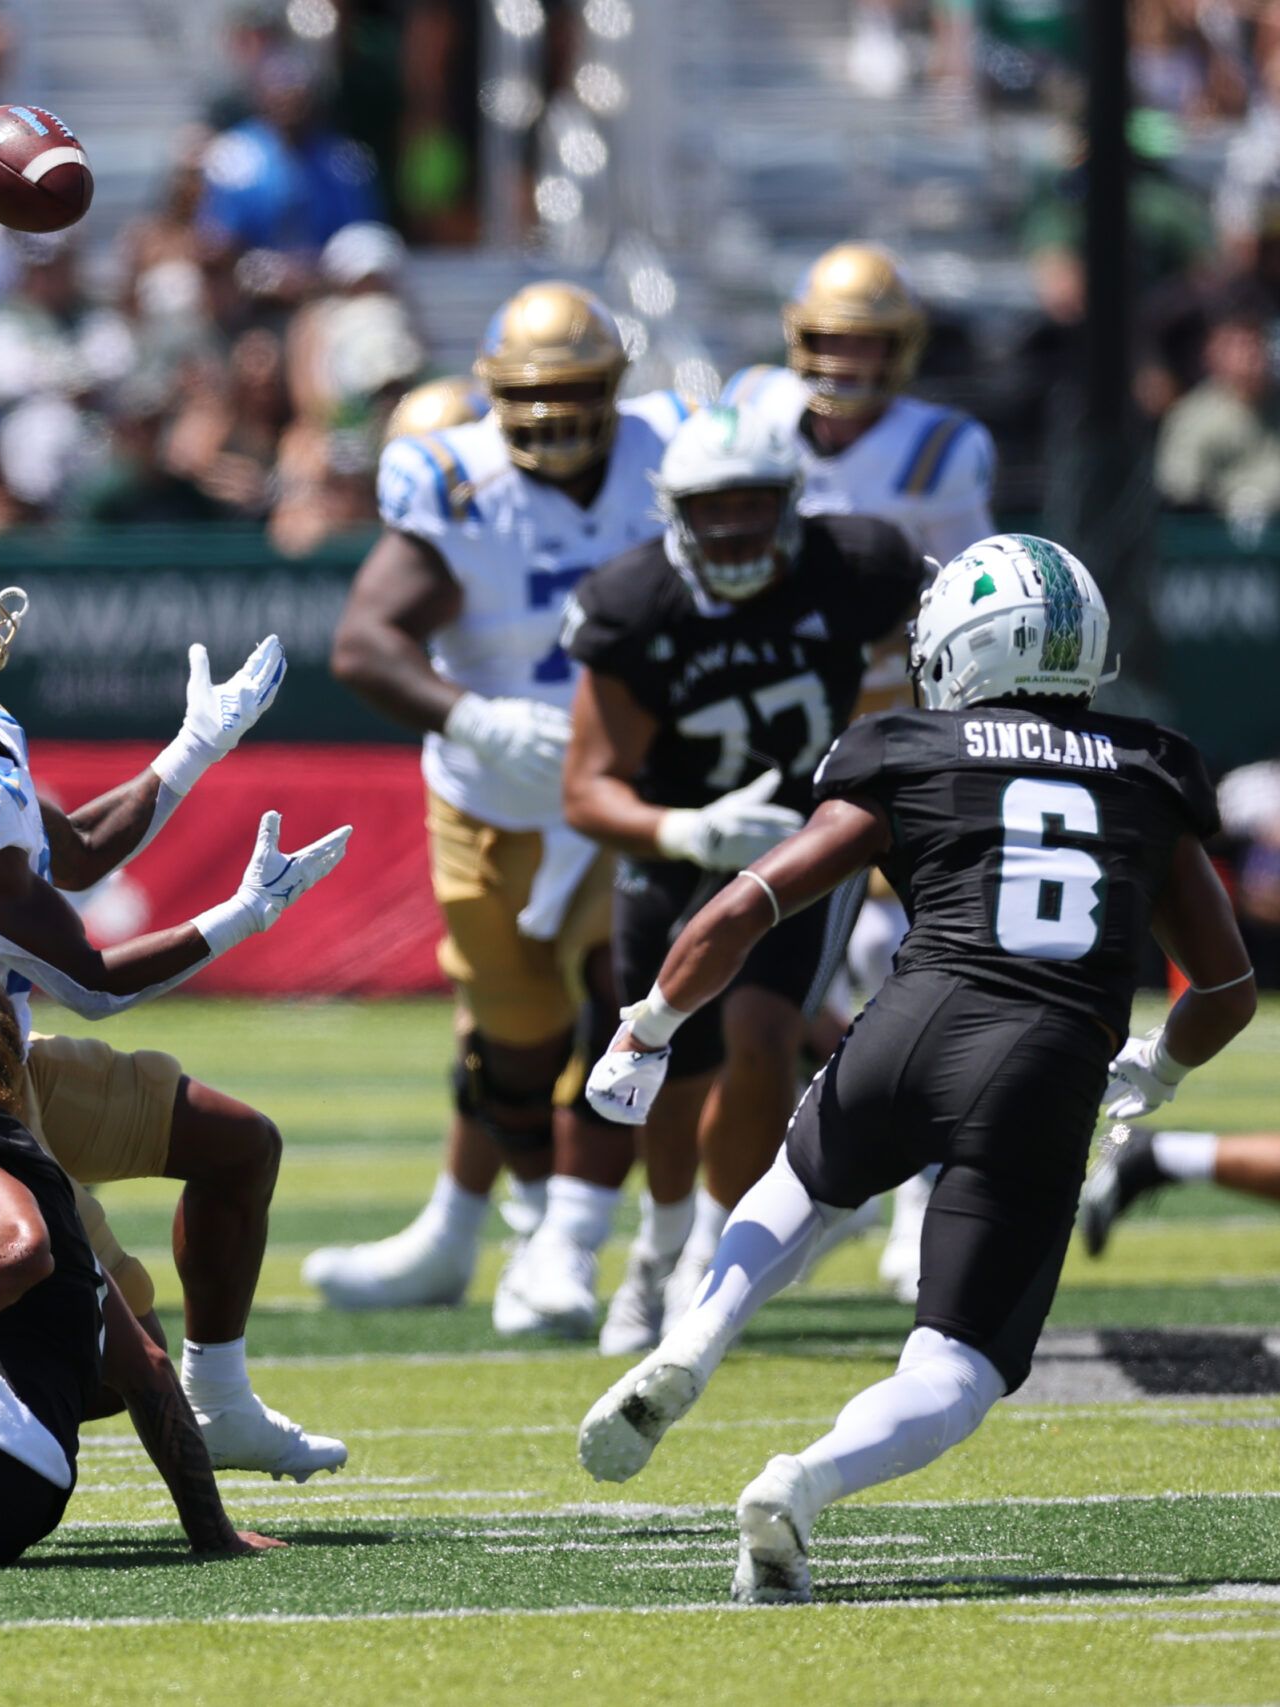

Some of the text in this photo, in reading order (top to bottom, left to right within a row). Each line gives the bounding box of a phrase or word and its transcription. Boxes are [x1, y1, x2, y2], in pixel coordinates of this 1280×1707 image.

[675, 671, 832, 793] 77
[964, 720, 1118, 770] SINCLAIR
[995, 776, 1107, 961] 6
